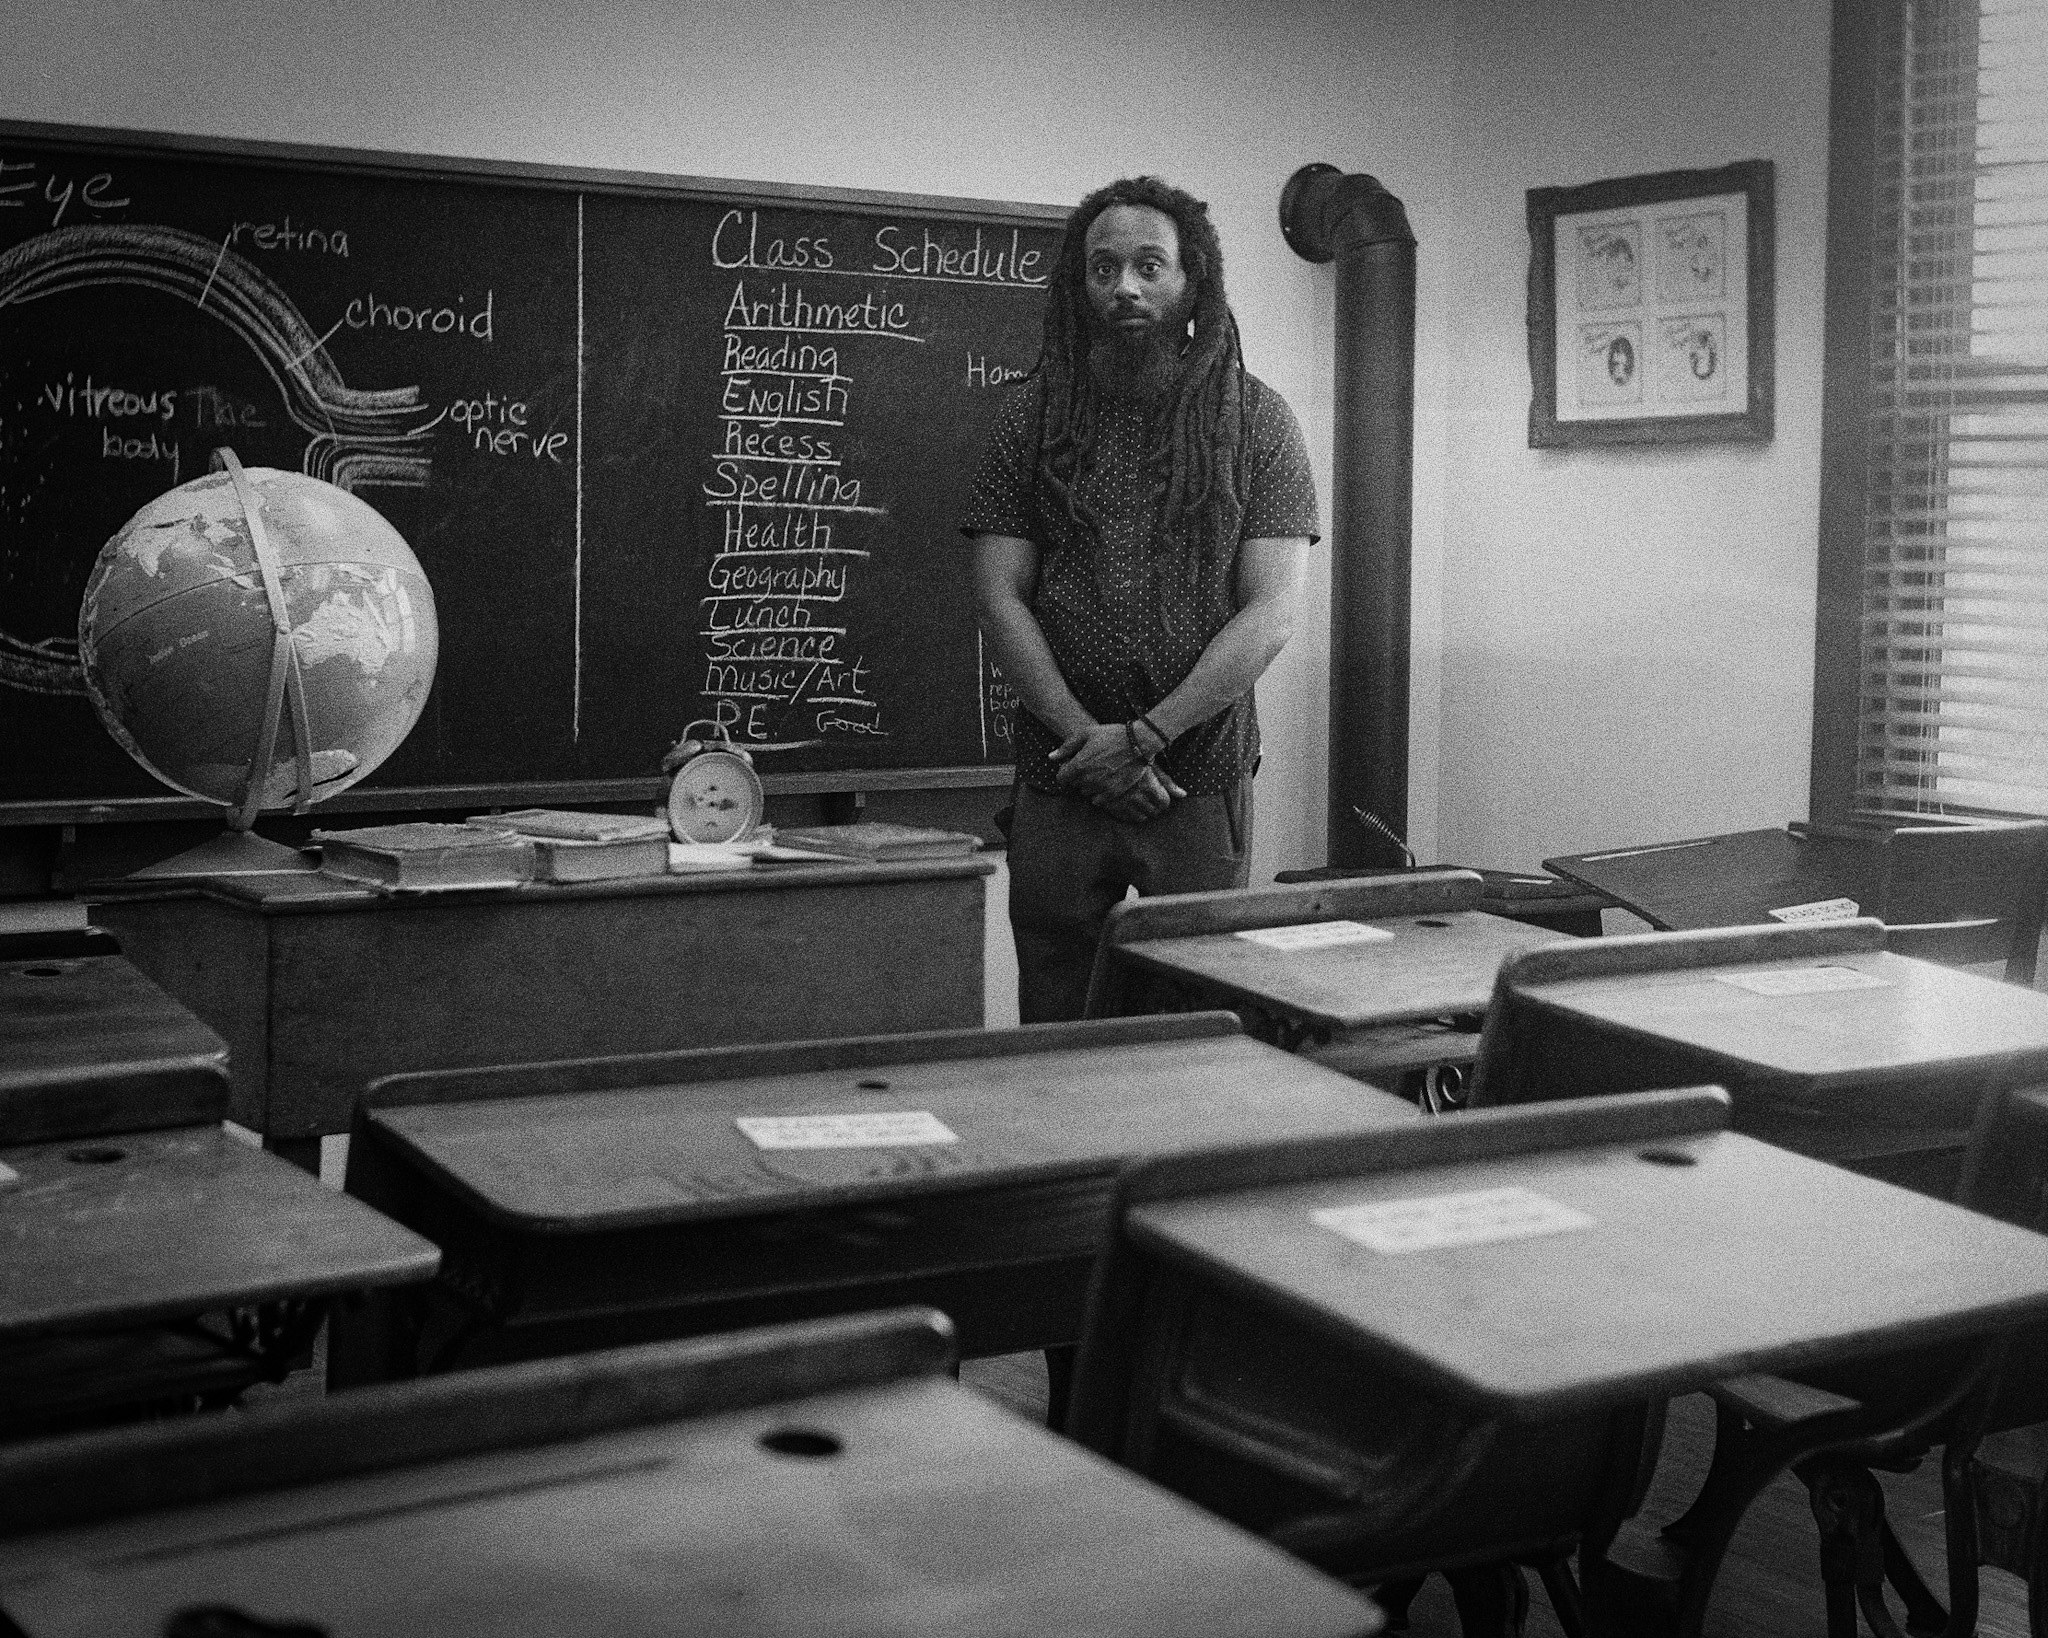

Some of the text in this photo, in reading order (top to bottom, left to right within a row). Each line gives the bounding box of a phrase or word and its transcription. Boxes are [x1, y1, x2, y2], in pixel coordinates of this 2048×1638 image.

[0, 159, 131, 228] Eye
[232, 214, 349, 258] retina
[711, 209, 1048, 284] Class Schedule
[345, 289, 494, 342] choroid
[723, 280, 910, 330] Arithmetic
[724, 334, 839, 380] Reading
[45, 371, 178, 421] vitreous
[450, 390, 528, 434] optic
[721, 377, 849, 428] English
[102, 425, 179, 485] body
[474, 426, 569, 463] nerve
[724, 421, 833, 460] Recess
[702, 461, 862, 509] Spelling
[724, 509, 832, 552] Health
[708, 557, 848, 603] Geography
[709, 600, 812, 631] Lunch
[705, 634, 840, 661] Science
